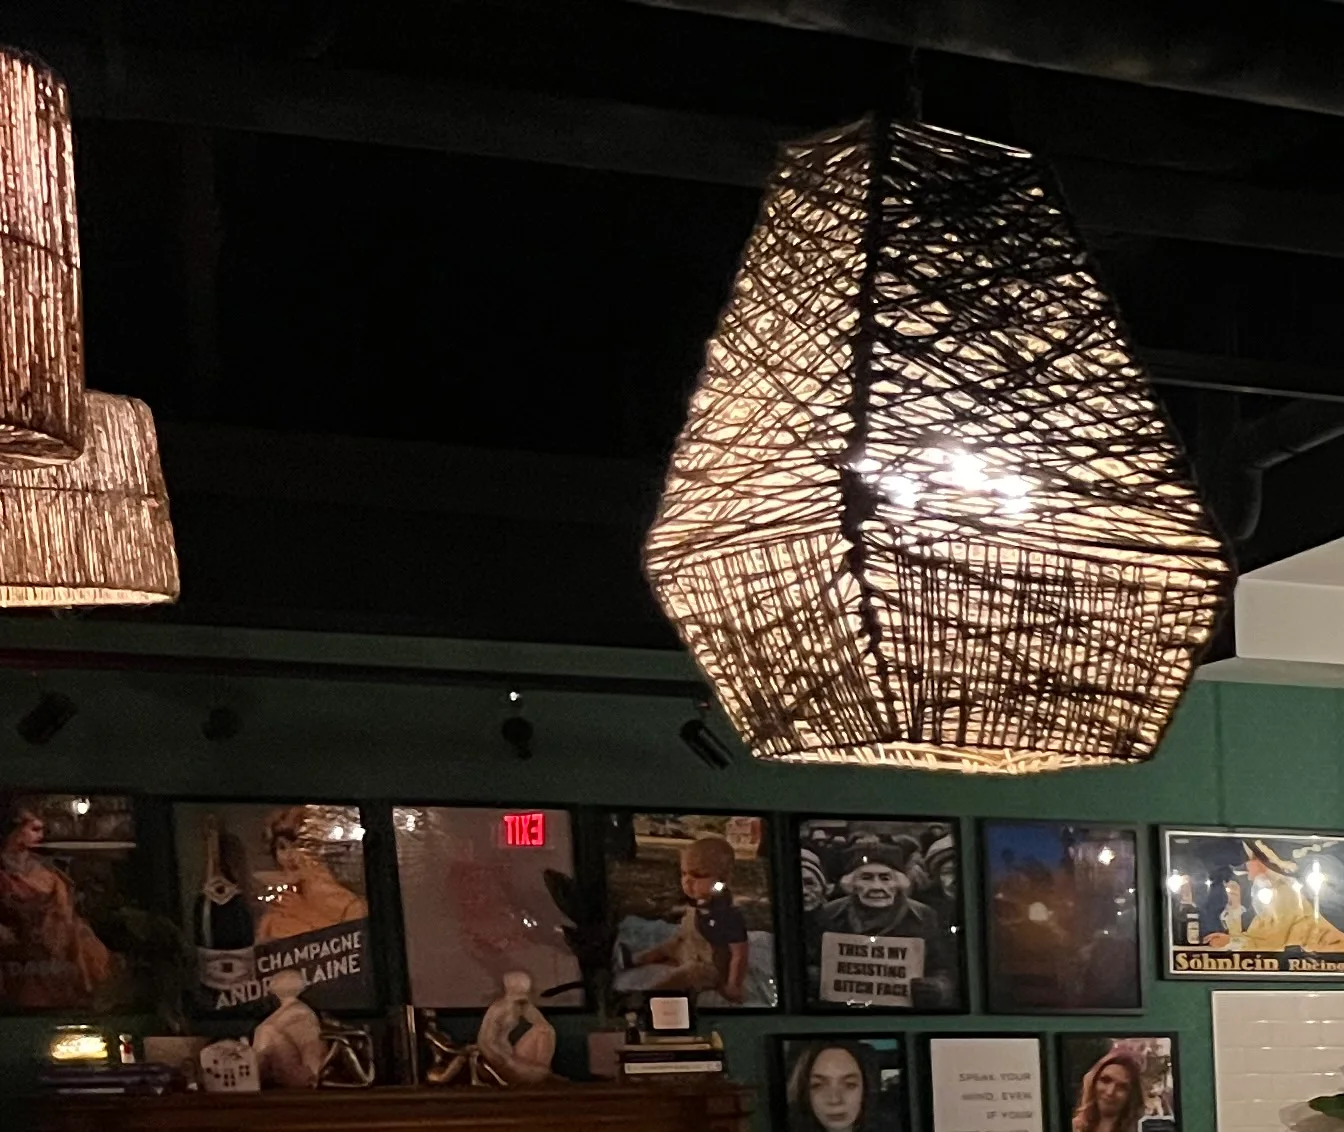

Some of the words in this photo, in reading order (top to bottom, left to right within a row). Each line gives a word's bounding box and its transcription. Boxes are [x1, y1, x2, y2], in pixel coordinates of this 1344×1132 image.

[257, 931, 363, 973] CHAMPAGNE
[838, 943, 869, 957] THIS
[871, 945, 884, 959] IS
[887, 946, 908, 960] MY
[1175, 952, 1280, 971] Söhnlein
[837, 962, 906, 978] RESISTING
[833, 979, 874, 994] BITCH
[876, 982, 909, 997] FACE
[958, 1072, 995, 1083] SPEAK
[1000, 1072, 1032, 1082] YOUR
[1001, 1091, 1033, 1101] EVEN
[986, 1110, 998, 1120] IF
[1001, 1110, 1033, 1120] YOUR
